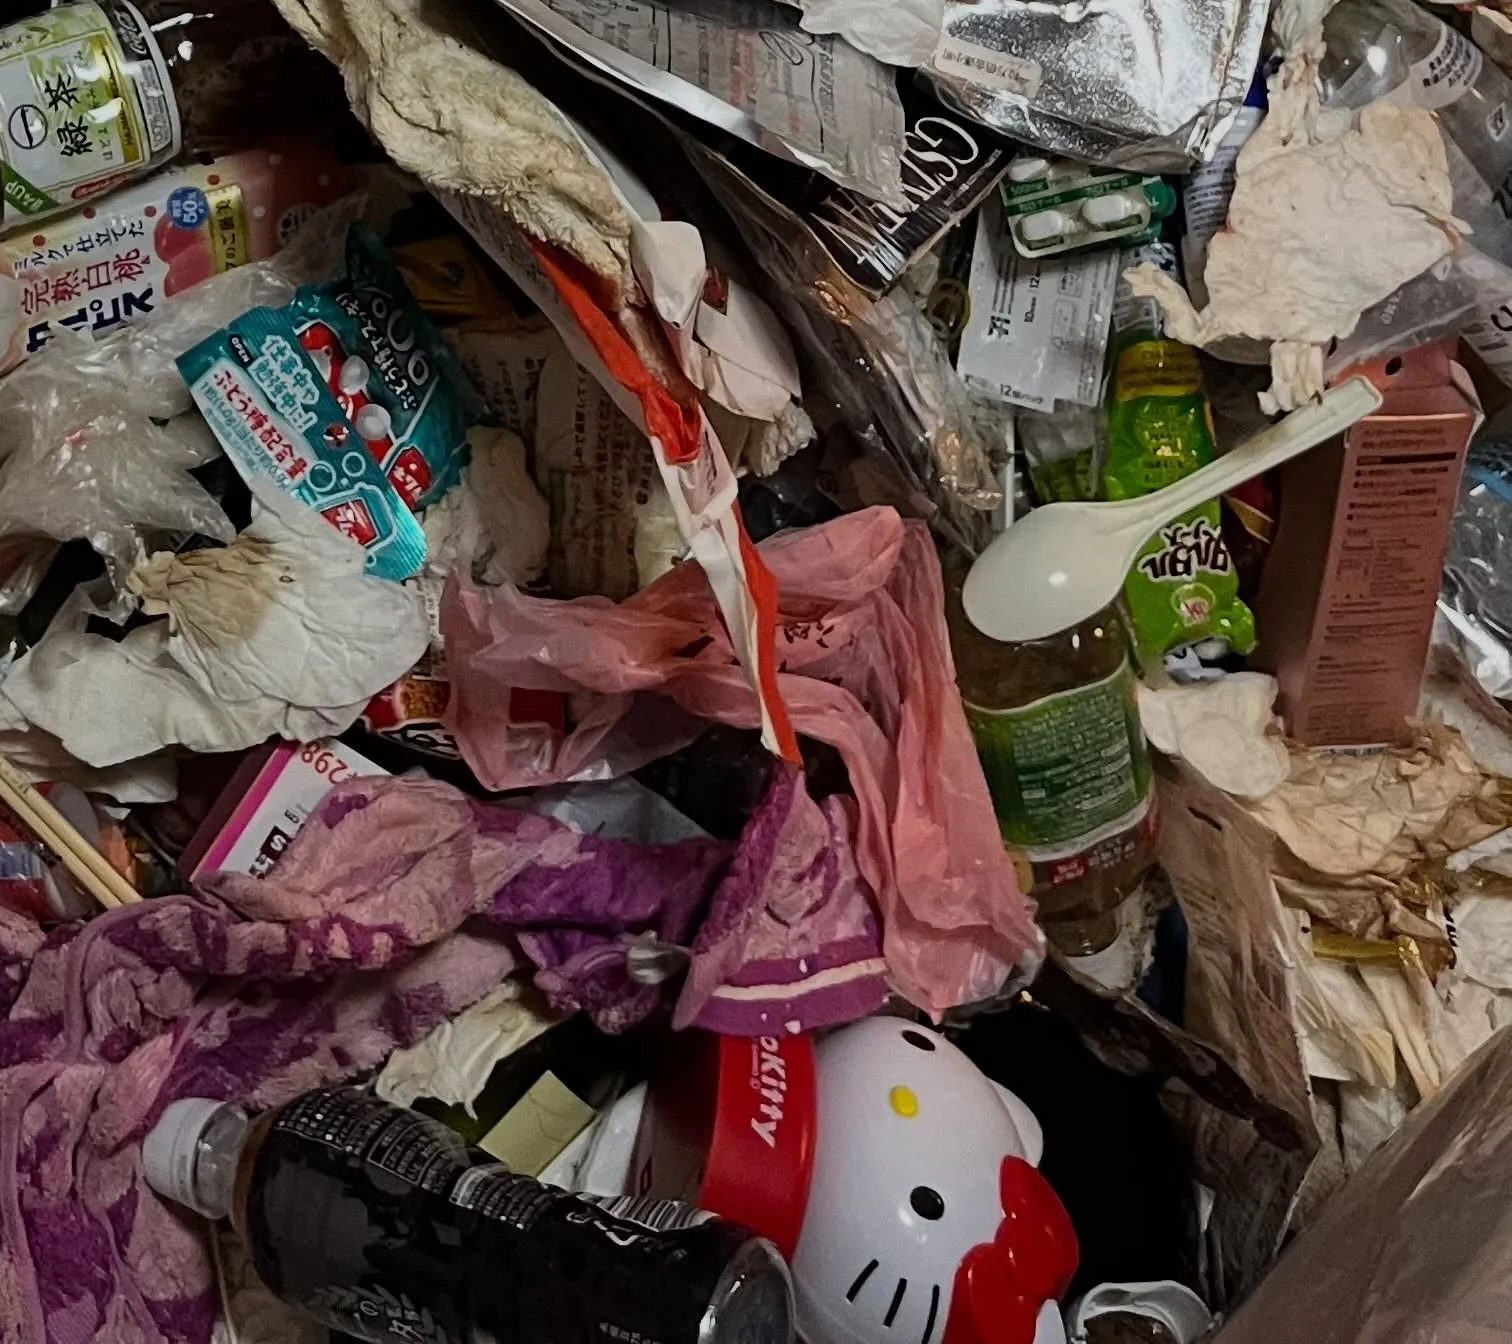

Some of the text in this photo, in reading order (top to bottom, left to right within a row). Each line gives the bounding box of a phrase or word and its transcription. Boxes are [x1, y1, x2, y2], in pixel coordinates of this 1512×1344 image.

[47, 71, 90, 158] 緑茶
[17, 247, 148, 316] 完熟白桃
[226, 334, 253, 365] OPEN
[258, 330, 323, 408] 仕事中や
[210, 361, 312, 483] ぶどう糖配合量
[1139, 538, 1228, 586] タルタル
[1162, 519, 1211, 546] ソース
